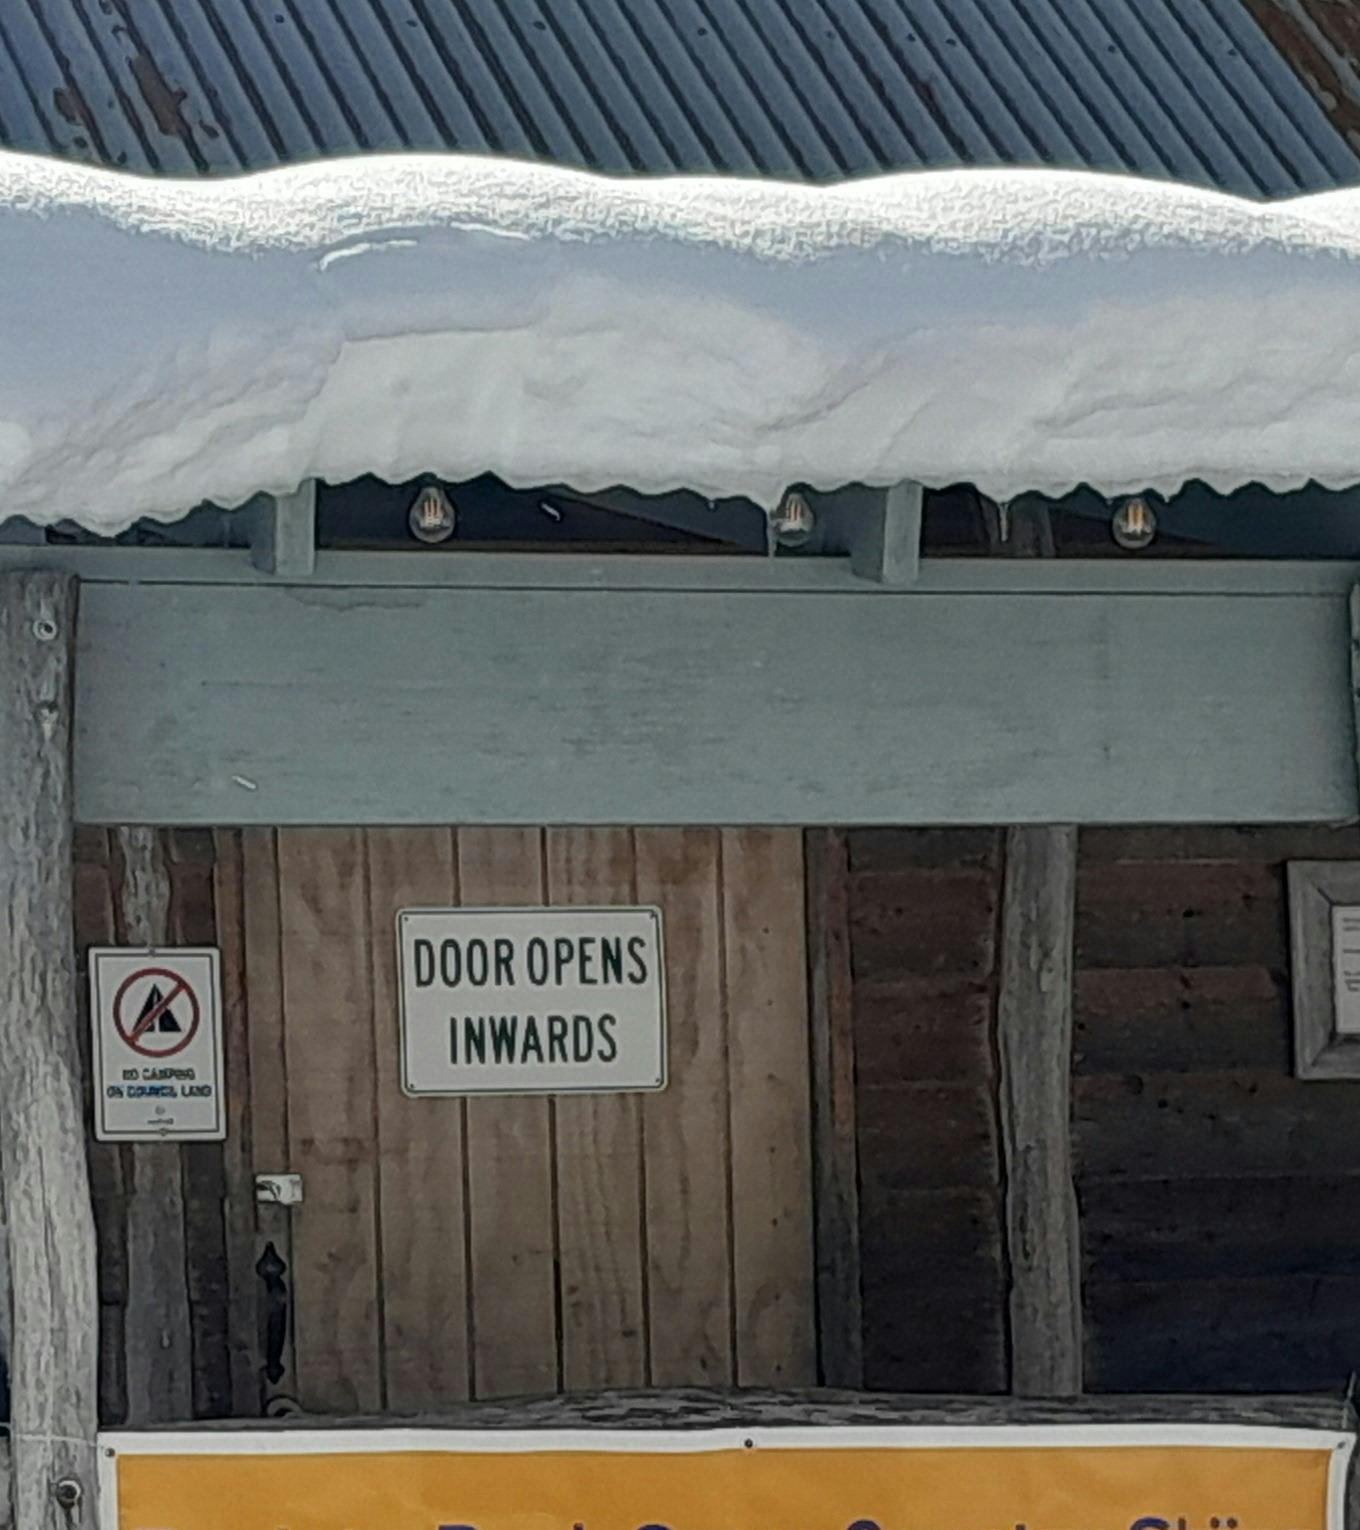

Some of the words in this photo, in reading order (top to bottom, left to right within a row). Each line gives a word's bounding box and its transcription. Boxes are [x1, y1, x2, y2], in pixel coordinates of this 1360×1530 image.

[414, 938, 515, 988] DOOR
[526, 936, 648, 986] OPENS
[450, 1013, 617, 1065] INWARDS
